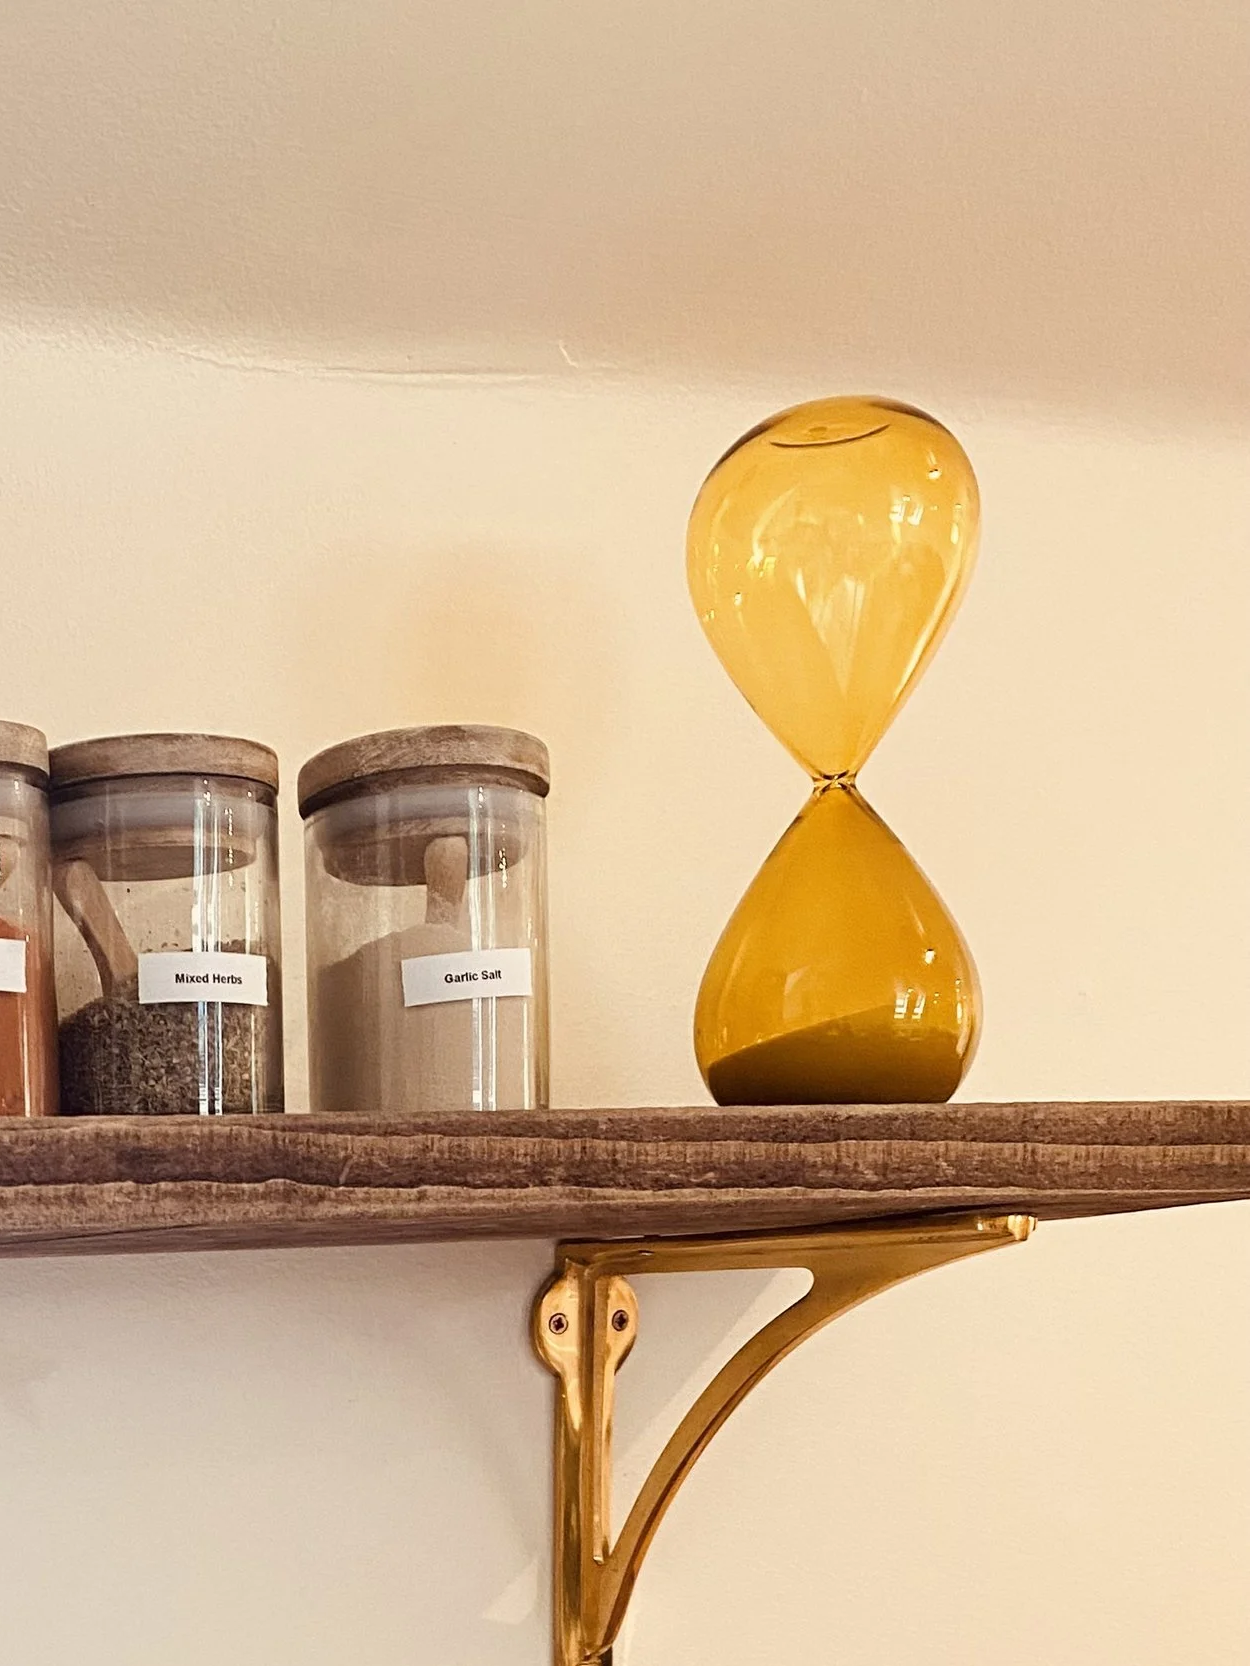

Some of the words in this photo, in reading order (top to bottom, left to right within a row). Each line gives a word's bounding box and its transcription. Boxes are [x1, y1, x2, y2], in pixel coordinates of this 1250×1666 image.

[174, 973, 210, 984] Mixed
[212, 973, 242, 985] Herbs
[444, 971, 479, 984] Garlic
[481, 969, 502, 981] Salt
